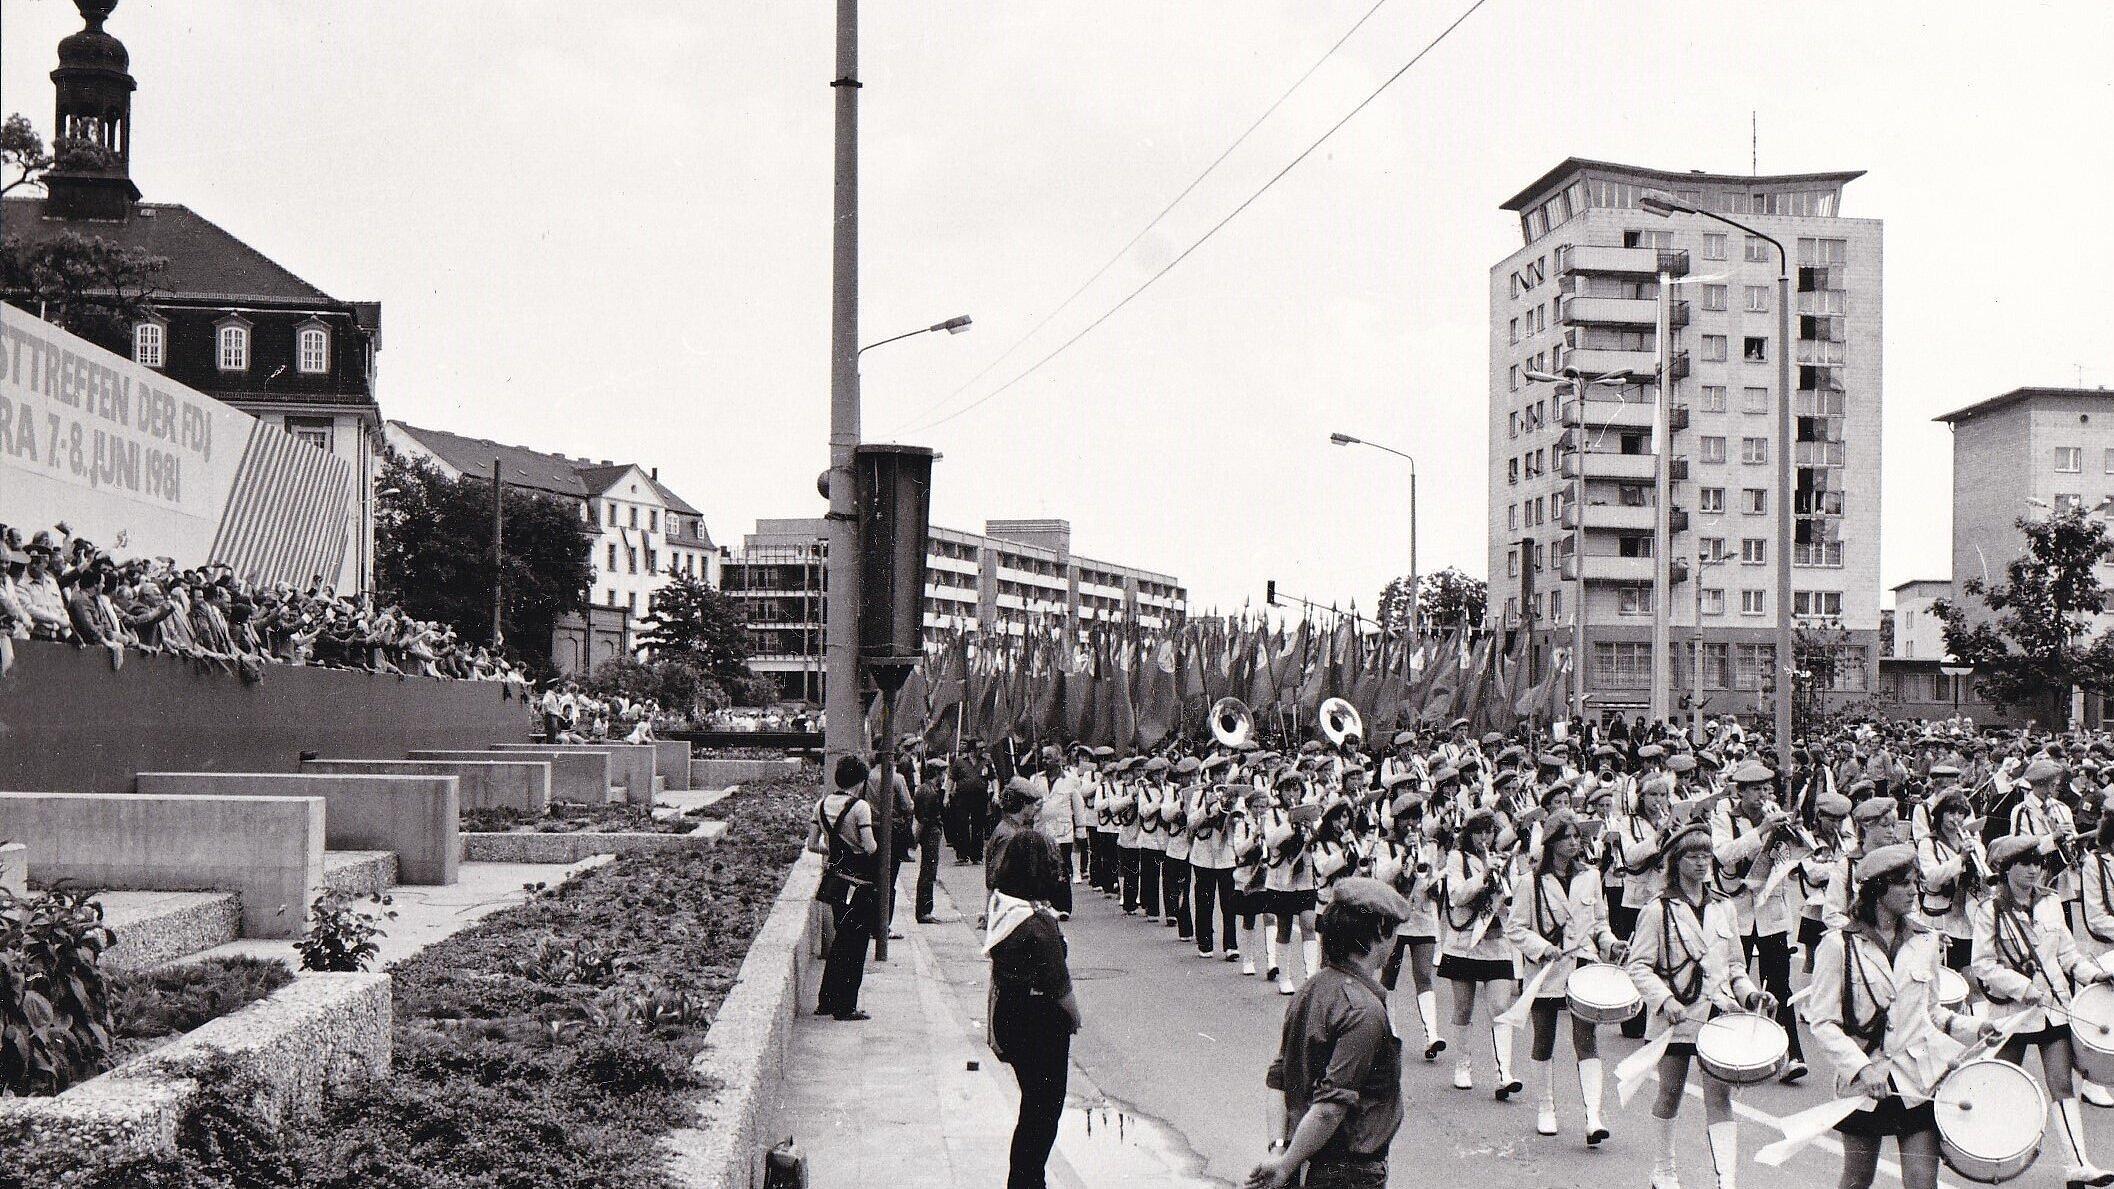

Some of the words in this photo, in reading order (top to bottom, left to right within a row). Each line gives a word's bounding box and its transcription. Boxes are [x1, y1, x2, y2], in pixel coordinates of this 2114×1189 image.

[138, 382, 177, 444] DER
[182, 402, 212, 464] FDJ
[89, 429, 140, 492] JUNI
[145, 447, 181, 503] 1981
